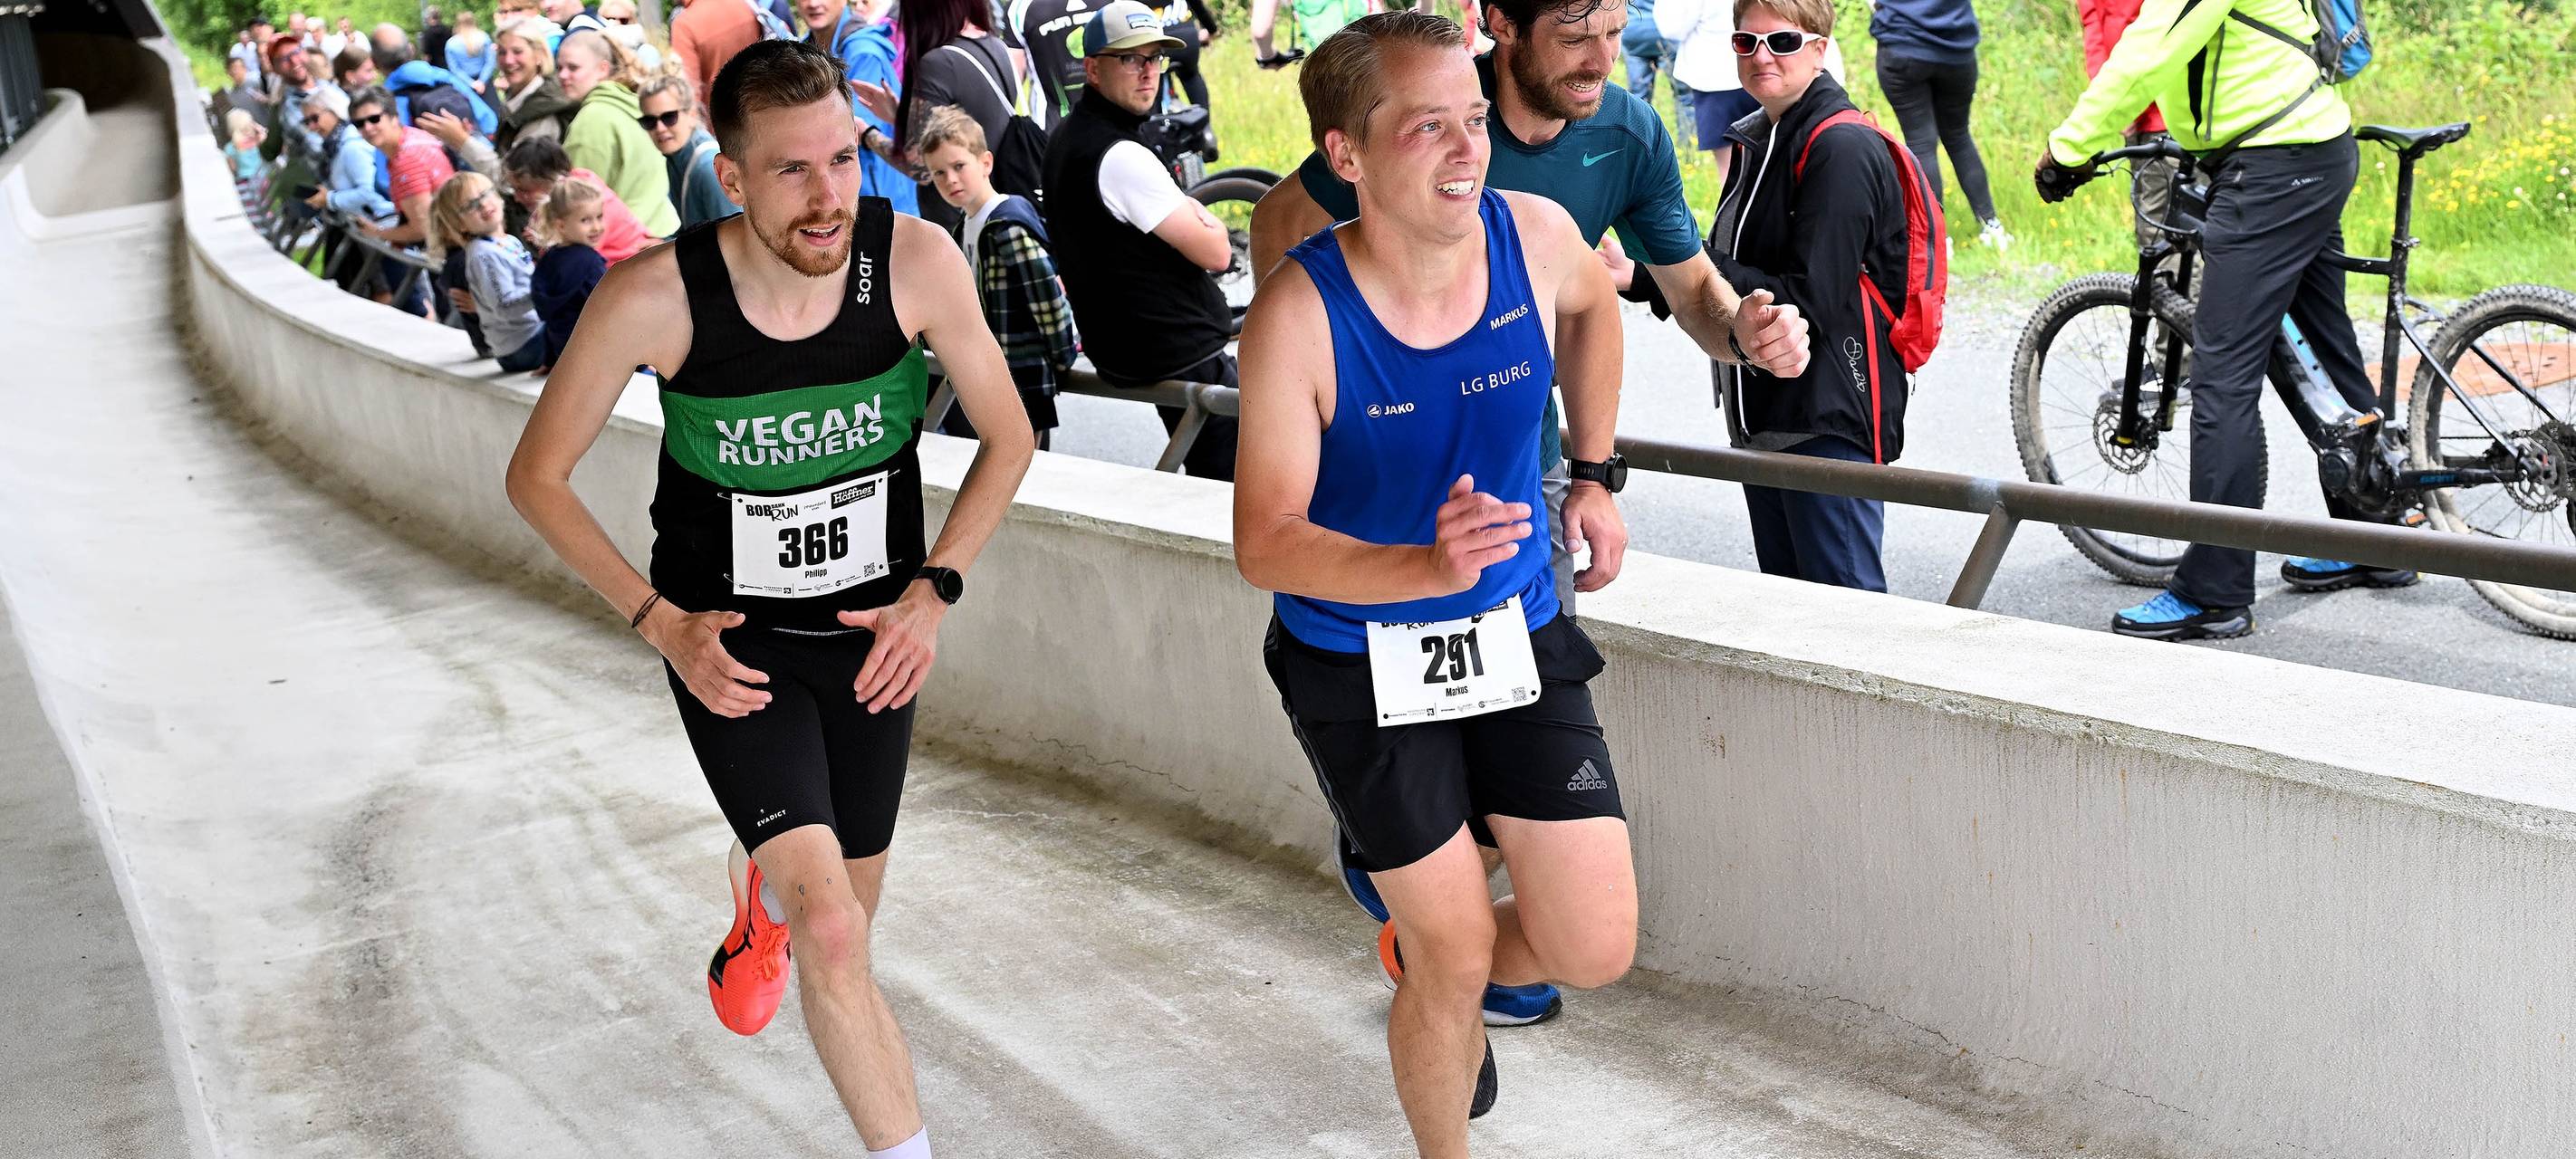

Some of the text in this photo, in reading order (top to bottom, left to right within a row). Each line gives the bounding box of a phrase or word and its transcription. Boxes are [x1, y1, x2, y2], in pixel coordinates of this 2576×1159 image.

[857, 251, 872, 304] soar
[1490, 303, 1529, 330] MARKUS
[1461, 360, 1531, 395] LG BURG
[1384, 402, 1415, 416] JAKO
[715, 393, 882, 446] VEGAN
[719, 419, 884, 466] RUNNERS
[832, 484, 874, 504] Höffner
[745, 504, 772, 517] BOB
[771, 504, 799, 522] RUN
[778, 516, 849, 569] 366
[804, 569, 828, 579] Philipp
[1420, 627, 1485, 684] 291
[1446, 685, 1468, 697] Markus
[1567, 779, 1608, 790] adidas
[756, 809, 786, 827] EVADICT
